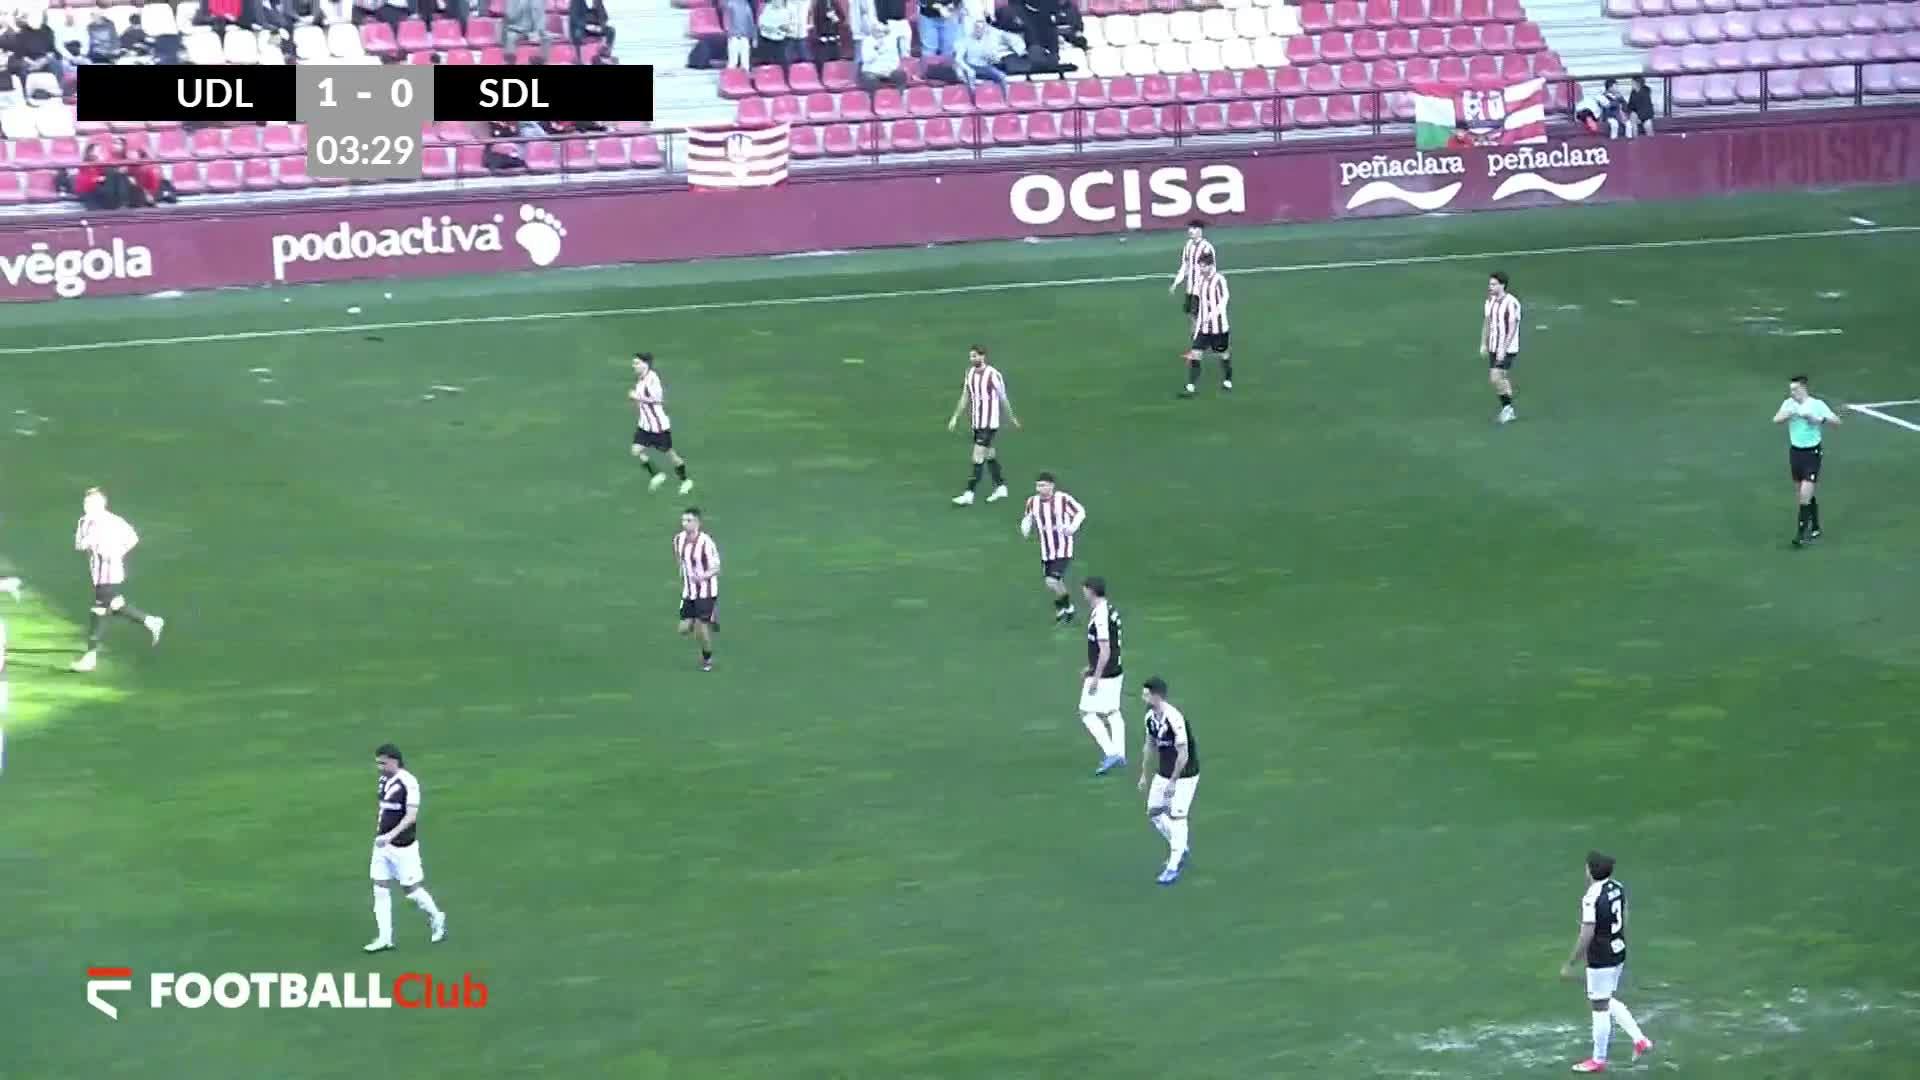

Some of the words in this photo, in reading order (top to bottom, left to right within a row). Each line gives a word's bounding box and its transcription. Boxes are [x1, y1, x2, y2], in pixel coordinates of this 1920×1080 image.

[1340, 152, 1465, 185] peñaclara
[1488, 142, 1610, 176] peñaclara
[272, 214, 503, 280] podoactiva
[1611, 899, 1623, 934] 3
